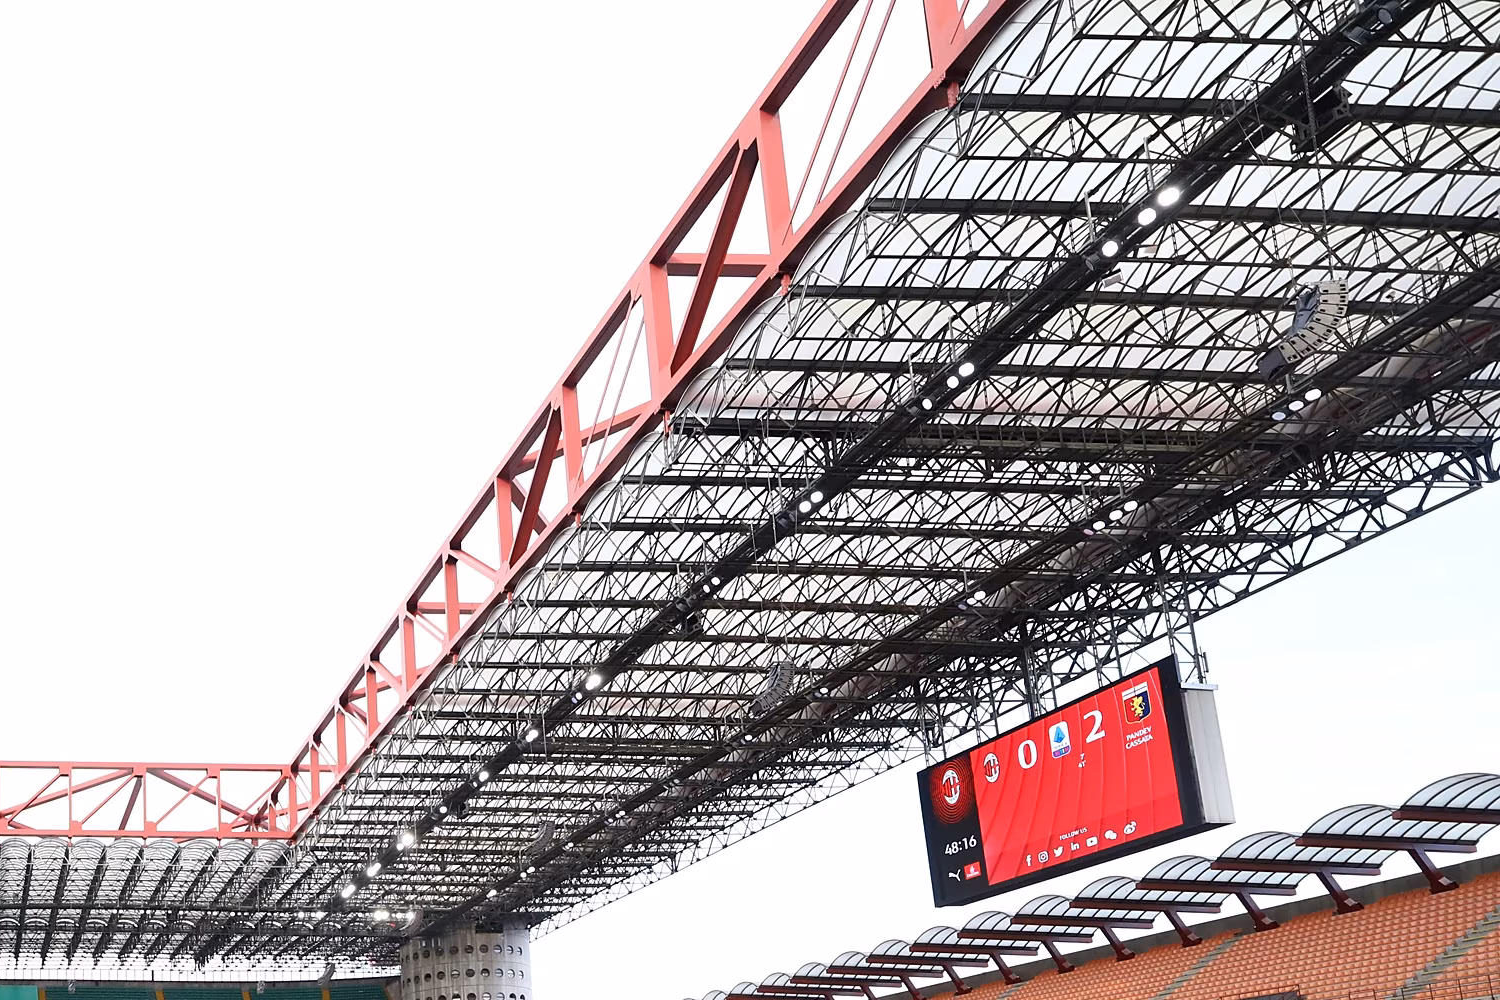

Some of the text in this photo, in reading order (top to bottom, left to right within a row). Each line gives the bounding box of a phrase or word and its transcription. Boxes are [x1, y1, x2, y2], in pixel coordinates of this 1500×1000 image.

[1083, 709, 1106, 744] 2
[1126, 725, 1152, 741] PANDEV
[1017, 739, 1038, 770] 0
[1058, 826, 1088, 841] FOLLOW US
[944, 834, 978, 855] 48:16
